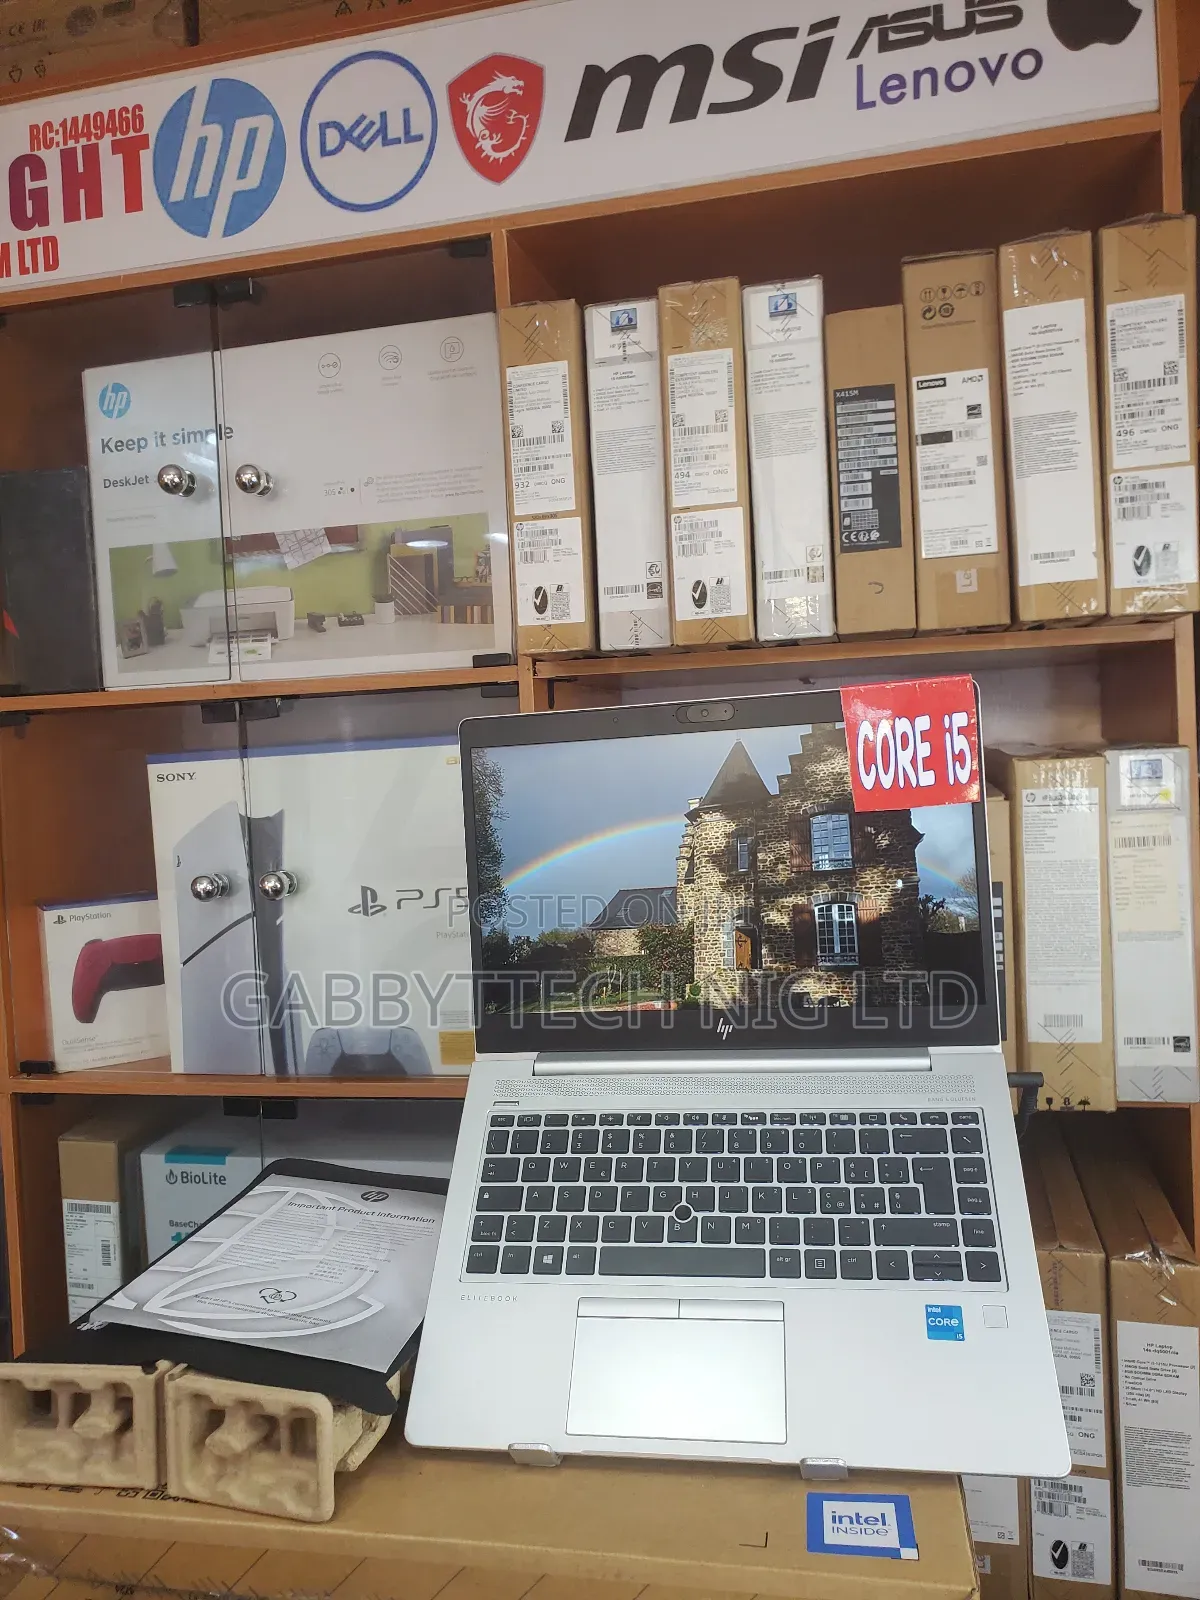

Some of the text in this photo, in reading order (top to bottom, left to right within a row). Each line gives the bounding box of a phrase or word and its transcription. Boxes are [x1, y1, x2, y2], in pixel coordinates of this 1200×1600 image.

[564, 16, 840, 143] msi
[856, 48, 1043, 111] Lenovo
[29, 104, 144, 153] RC:1449466
[319, 108, 424, 164] DELL
[169, 80, 274, 238] hp
[8, 135, 149, 232] GHT
[17, 235, 60, 277] LTD
[918, 379, 945, 388] Lenovo
[103, 383, 128, 419] hp
[1116, 424, 1179, 437] 496 ONG
[101, 436, 148, 454] Keep
[154, 431, 166, 447] it
[103, 475, 149, 489] DeskJet
[674, 471, 691, 479] 494
[514, 481, 530, 489] 932
[857, 711, 972, 791] CORE i5
[156, 772, 196, 783] SONY
[69, 912, 112, 923] PlayStation
[181, 1171, 226, 1186] BioLite
[288, 1201, 436, 1224] Important Product Information
[169, 1219, 202, 1229] BaseCh
[675, 1222, 682, 1230] B
[1078, 1431, 1096, 1439] ONG
[831, 1511, 888, 1527] intel
